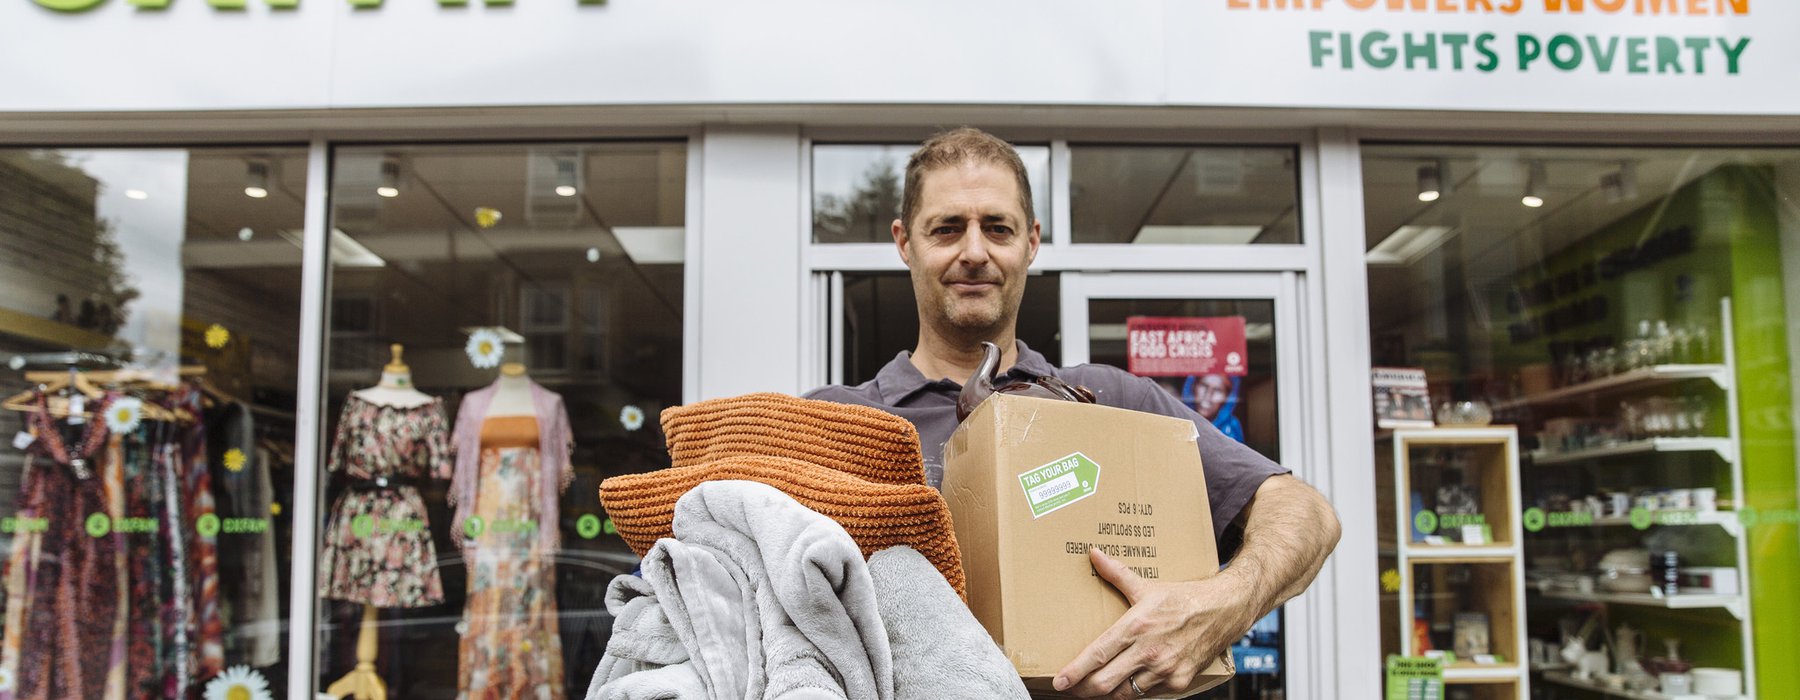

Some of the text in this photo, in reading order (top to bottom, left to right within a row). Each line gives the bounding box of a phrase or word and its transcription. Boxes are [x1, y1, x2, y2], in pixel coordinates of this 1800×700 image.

[1308, 30, 1751, 75] FIGHTS POVERTY
[1130, 330, 1217, 345] EAST AFRICA
[1130, 343, 1213, 358] FOOD CRISIS
[1023, 457, 1080, 487] TAG YOUR BAG
[1118, 502, 1153, 515] QTY: 6 PCS
[1098, 522, 1155, 537] LED SS SPOTLIGHT
[1120, 545, 1140, 557] NAME:
[1141, 546, 1157, 557] ITEM
[1144, 567, 1159, 578] ITEM
